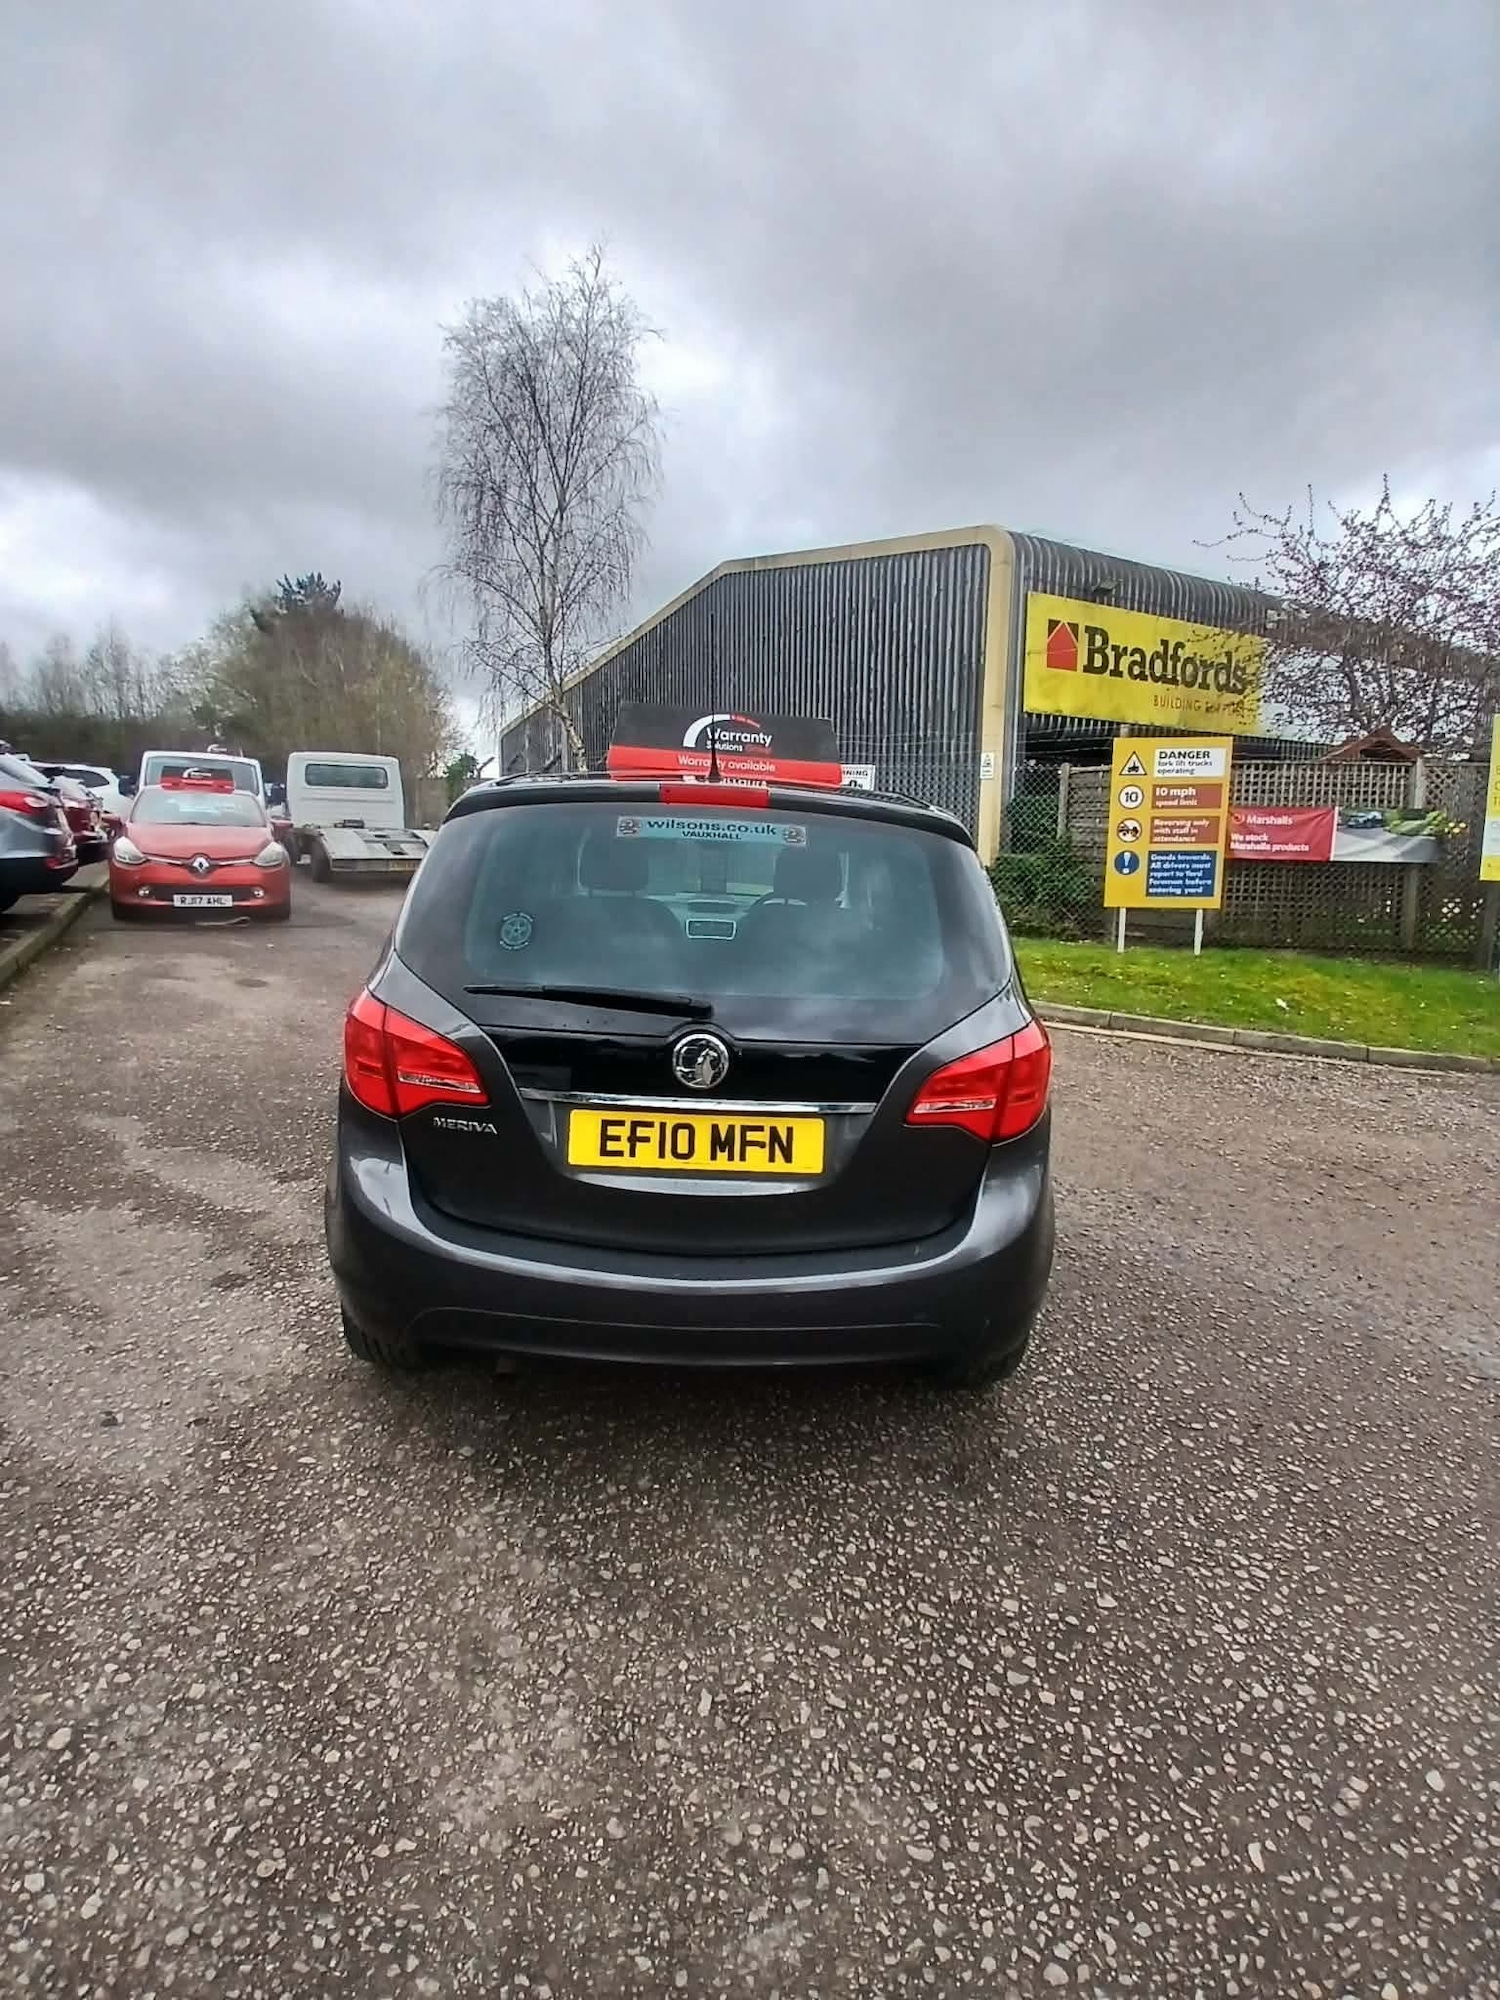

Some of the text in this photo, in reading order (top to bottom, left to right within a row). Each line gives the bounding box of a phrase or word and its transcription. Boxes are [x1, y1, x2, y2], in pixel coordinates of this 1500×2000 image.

[1083, 624, 1247, 695] Bradfords
[1153, 694, 1202, 713] BUILDING
[706, 726, 773, 748] Warranty
[706, 739, 743, 753] Slutions
[1158, 750, 1211, 760] DANGER
[678, 754, 776, 774] Warraty available
[1124, 790, 1139, 803] 10
[1155, 787, 1197, 798] 10 mph
[646, 818, 778, 836] wilsons.co.uk
[1246, 815, 1293, 825] Marshalls
[682, 830, 743, 841] VAUXHALL
[1231, 833, 1268, 841] We stock
[1272, 843, 1309, 852] products
[432, 1115, 498, 1135] MERIVA
[599, 1118, 794, 1165] EF10 MFN
